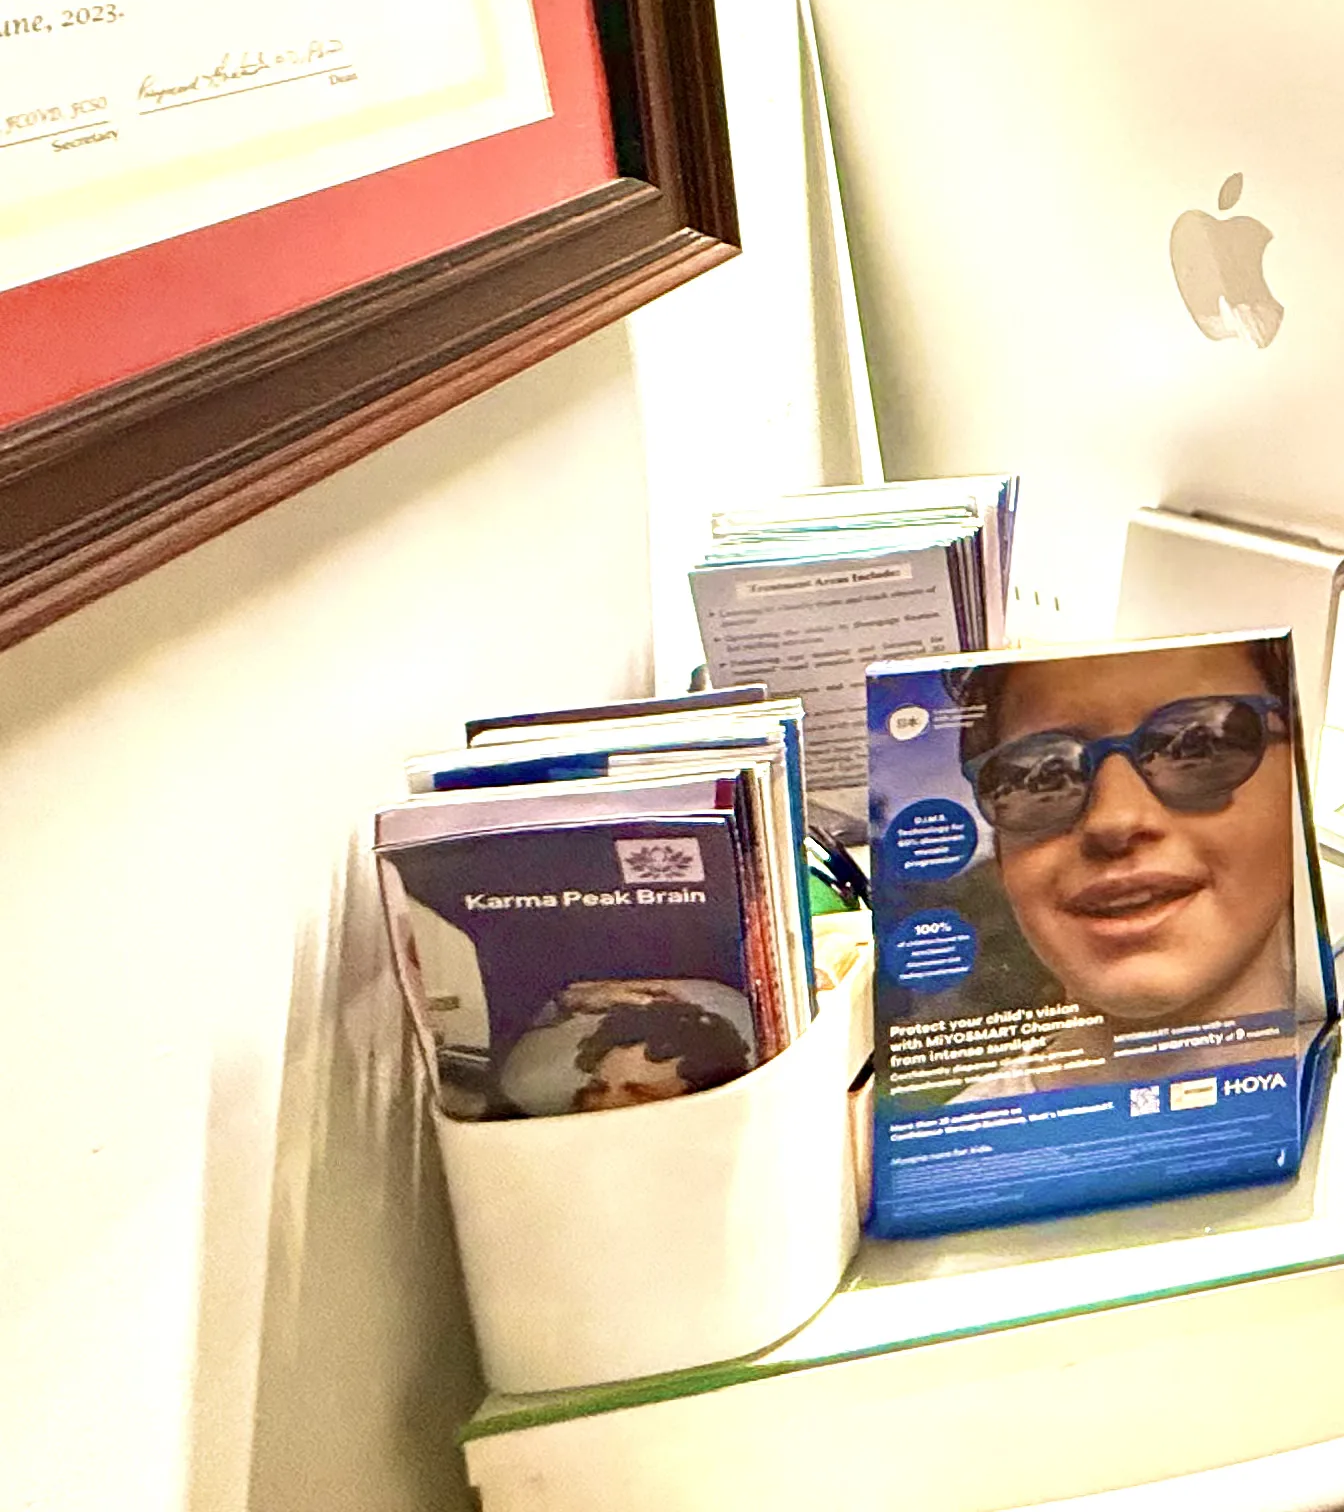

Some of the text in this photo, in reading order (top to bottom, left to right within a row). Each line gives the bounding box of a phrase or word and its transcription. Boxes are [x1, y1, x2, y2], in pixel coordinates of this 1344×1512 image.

[464, 888, 706, 911] Karma Peak Brain
[914, 922, 952, 936] 100%
[890, 1003, 1079, 1037] Protect your child's vision
[890, 1038, 922, 1053] with
[1021, 1015, 1104, 1035] Chameleon
[1159, 1033, 1223, 1050] warranty
[890, 1036, 1046, 1068] from intense sunlight
[1224, 1073, 1287, 1095] HOYA
